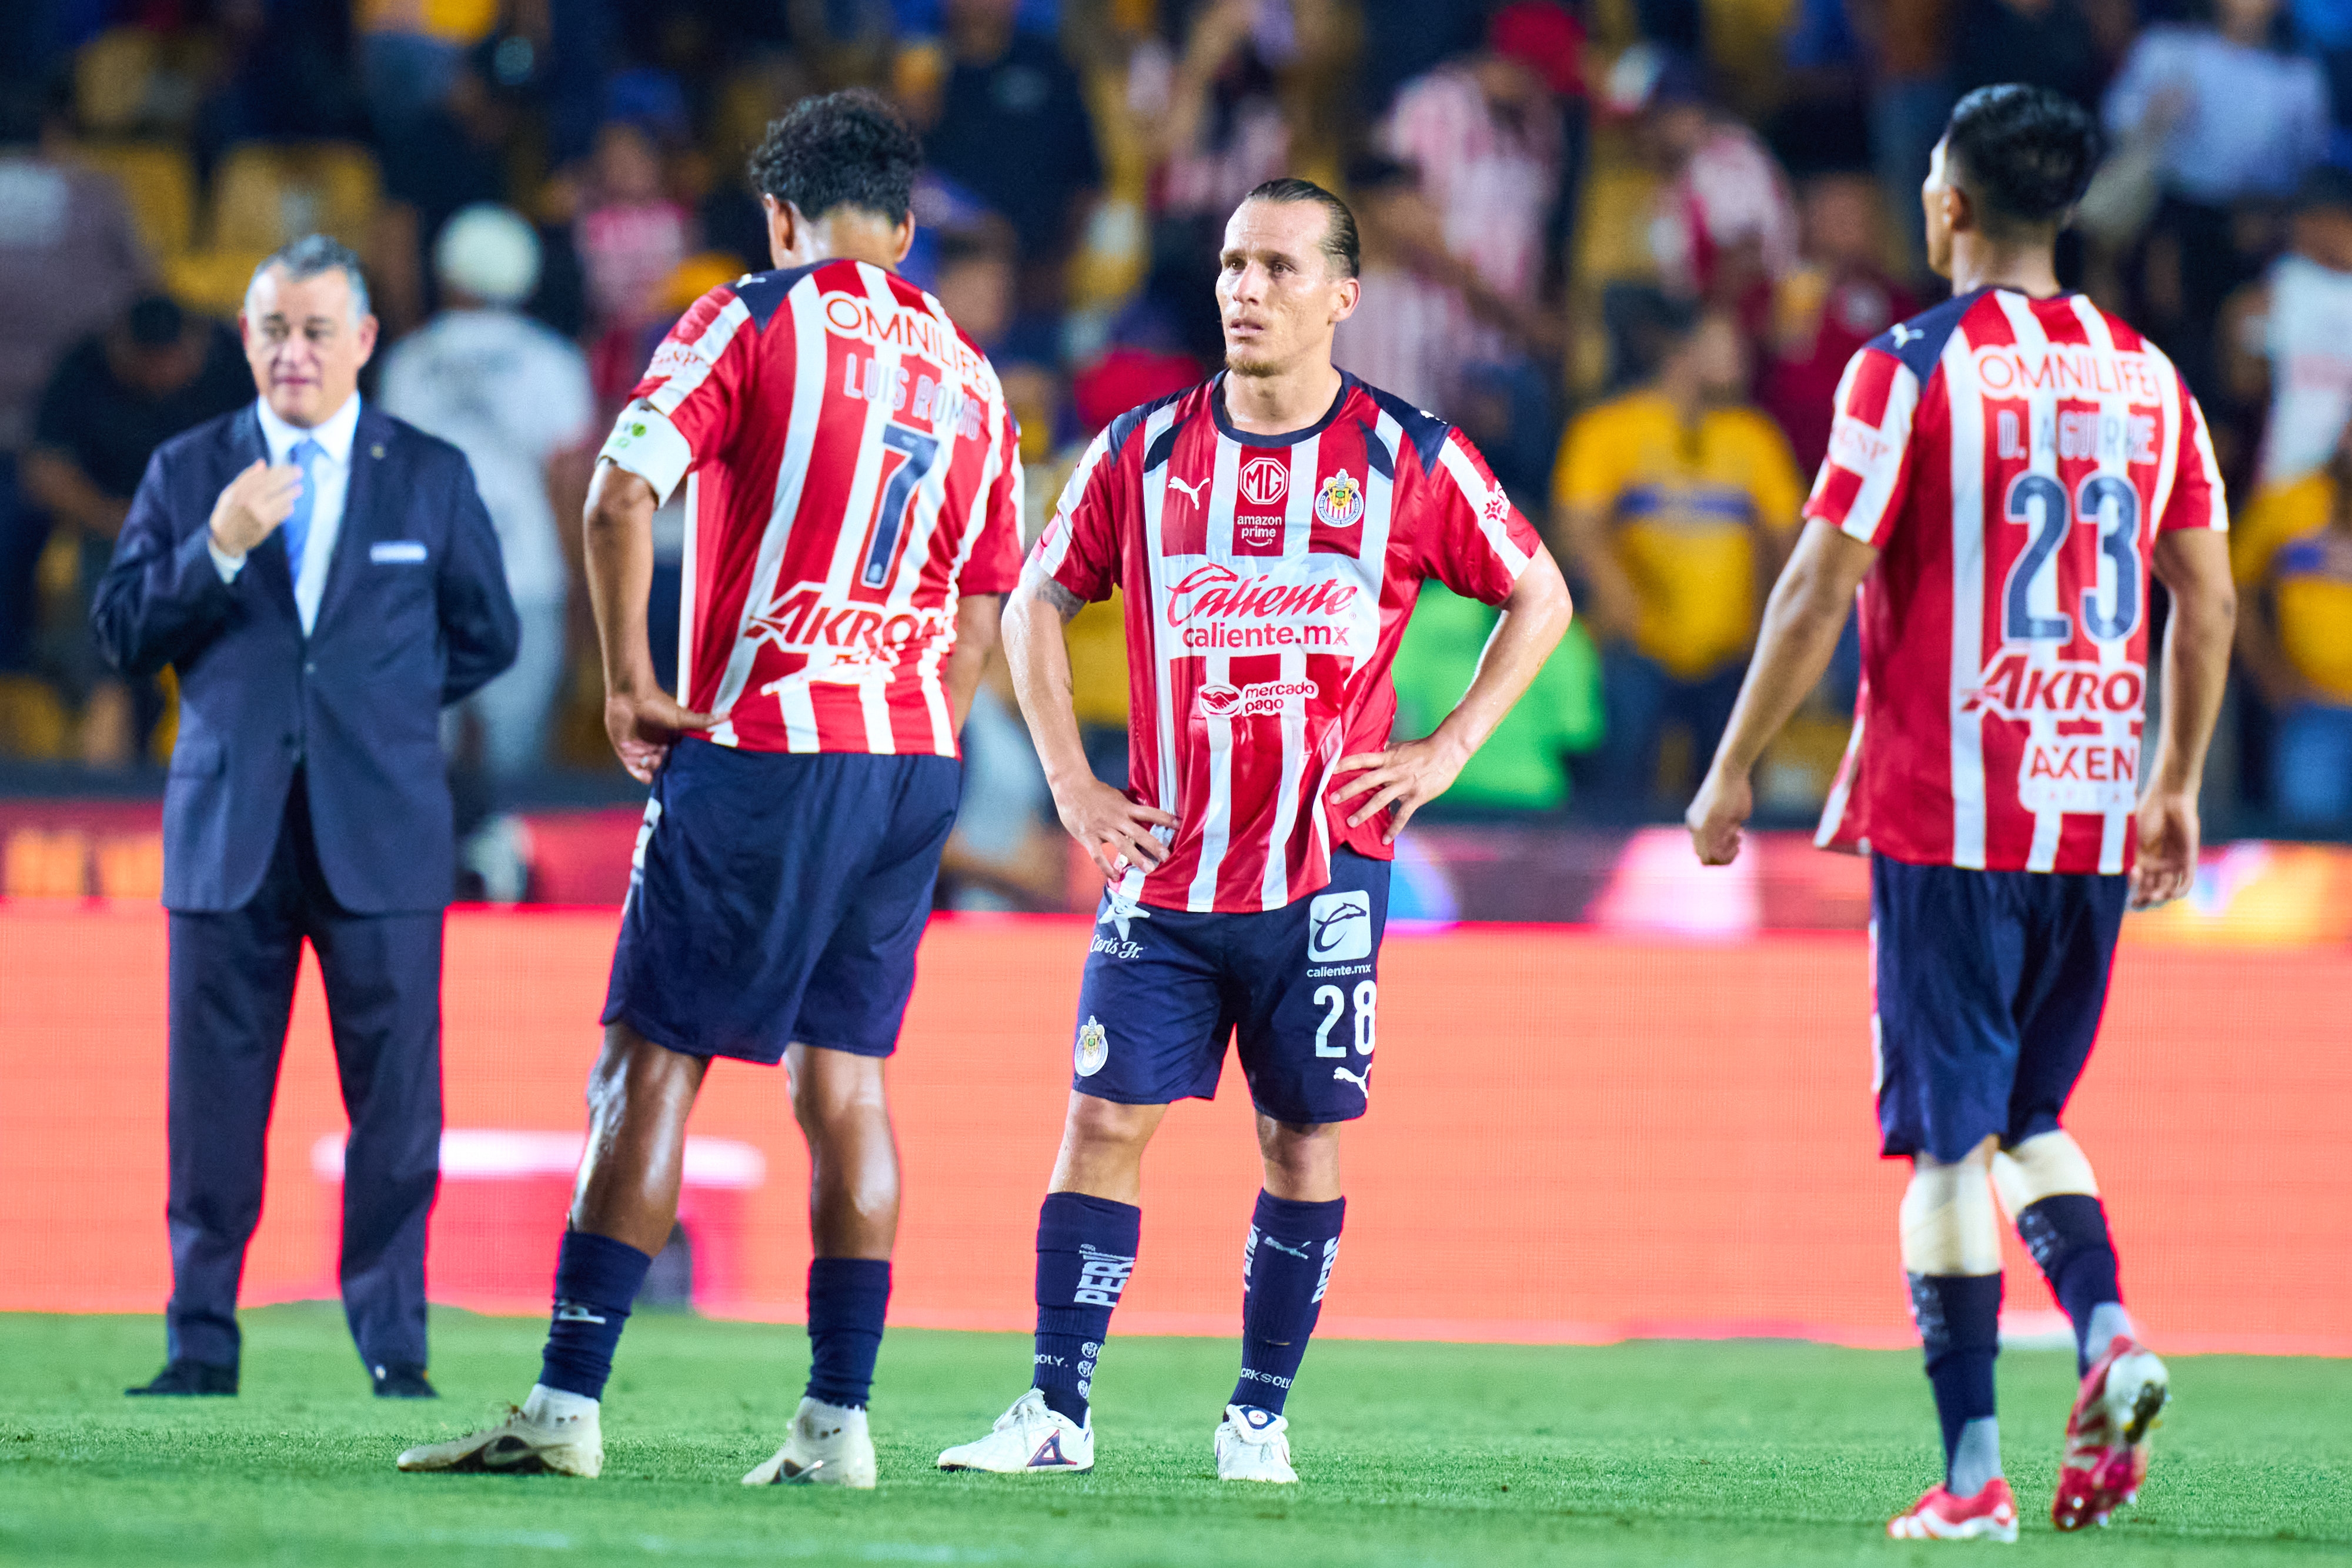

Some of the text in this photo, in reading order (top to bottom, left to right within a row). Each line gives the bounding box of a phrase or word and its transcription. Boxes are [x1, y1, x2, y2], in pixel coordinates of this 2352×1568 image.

[843, 352, 910, 412] LUIS
[1979, 353, 2154, 397] OMNILIFE
[1242, 460, 1285, 502] MG
[862, 422, 940, 588] 7
[1237, 515, 1282, 526] amazon
[1241, 526, 1277, 539] prime
[2002, 471, 2141, 644] 23
[1165, 561, 1358, 628] Caliente
[1182, 621, 1350, 648] caliente.mx
[1245, 682, 1315, 699] mercado
[1960, 653, 2145, 713] AKRO
[1244, 698, 1284, 714] pago
[2029, 744, 2136, 782] AXEN
[1090, 934, 1144, 959] Carl's Jr.
[1307, 963, 1371, 978] caliente.mx
[1313, 979, 1377, 1058] 28
